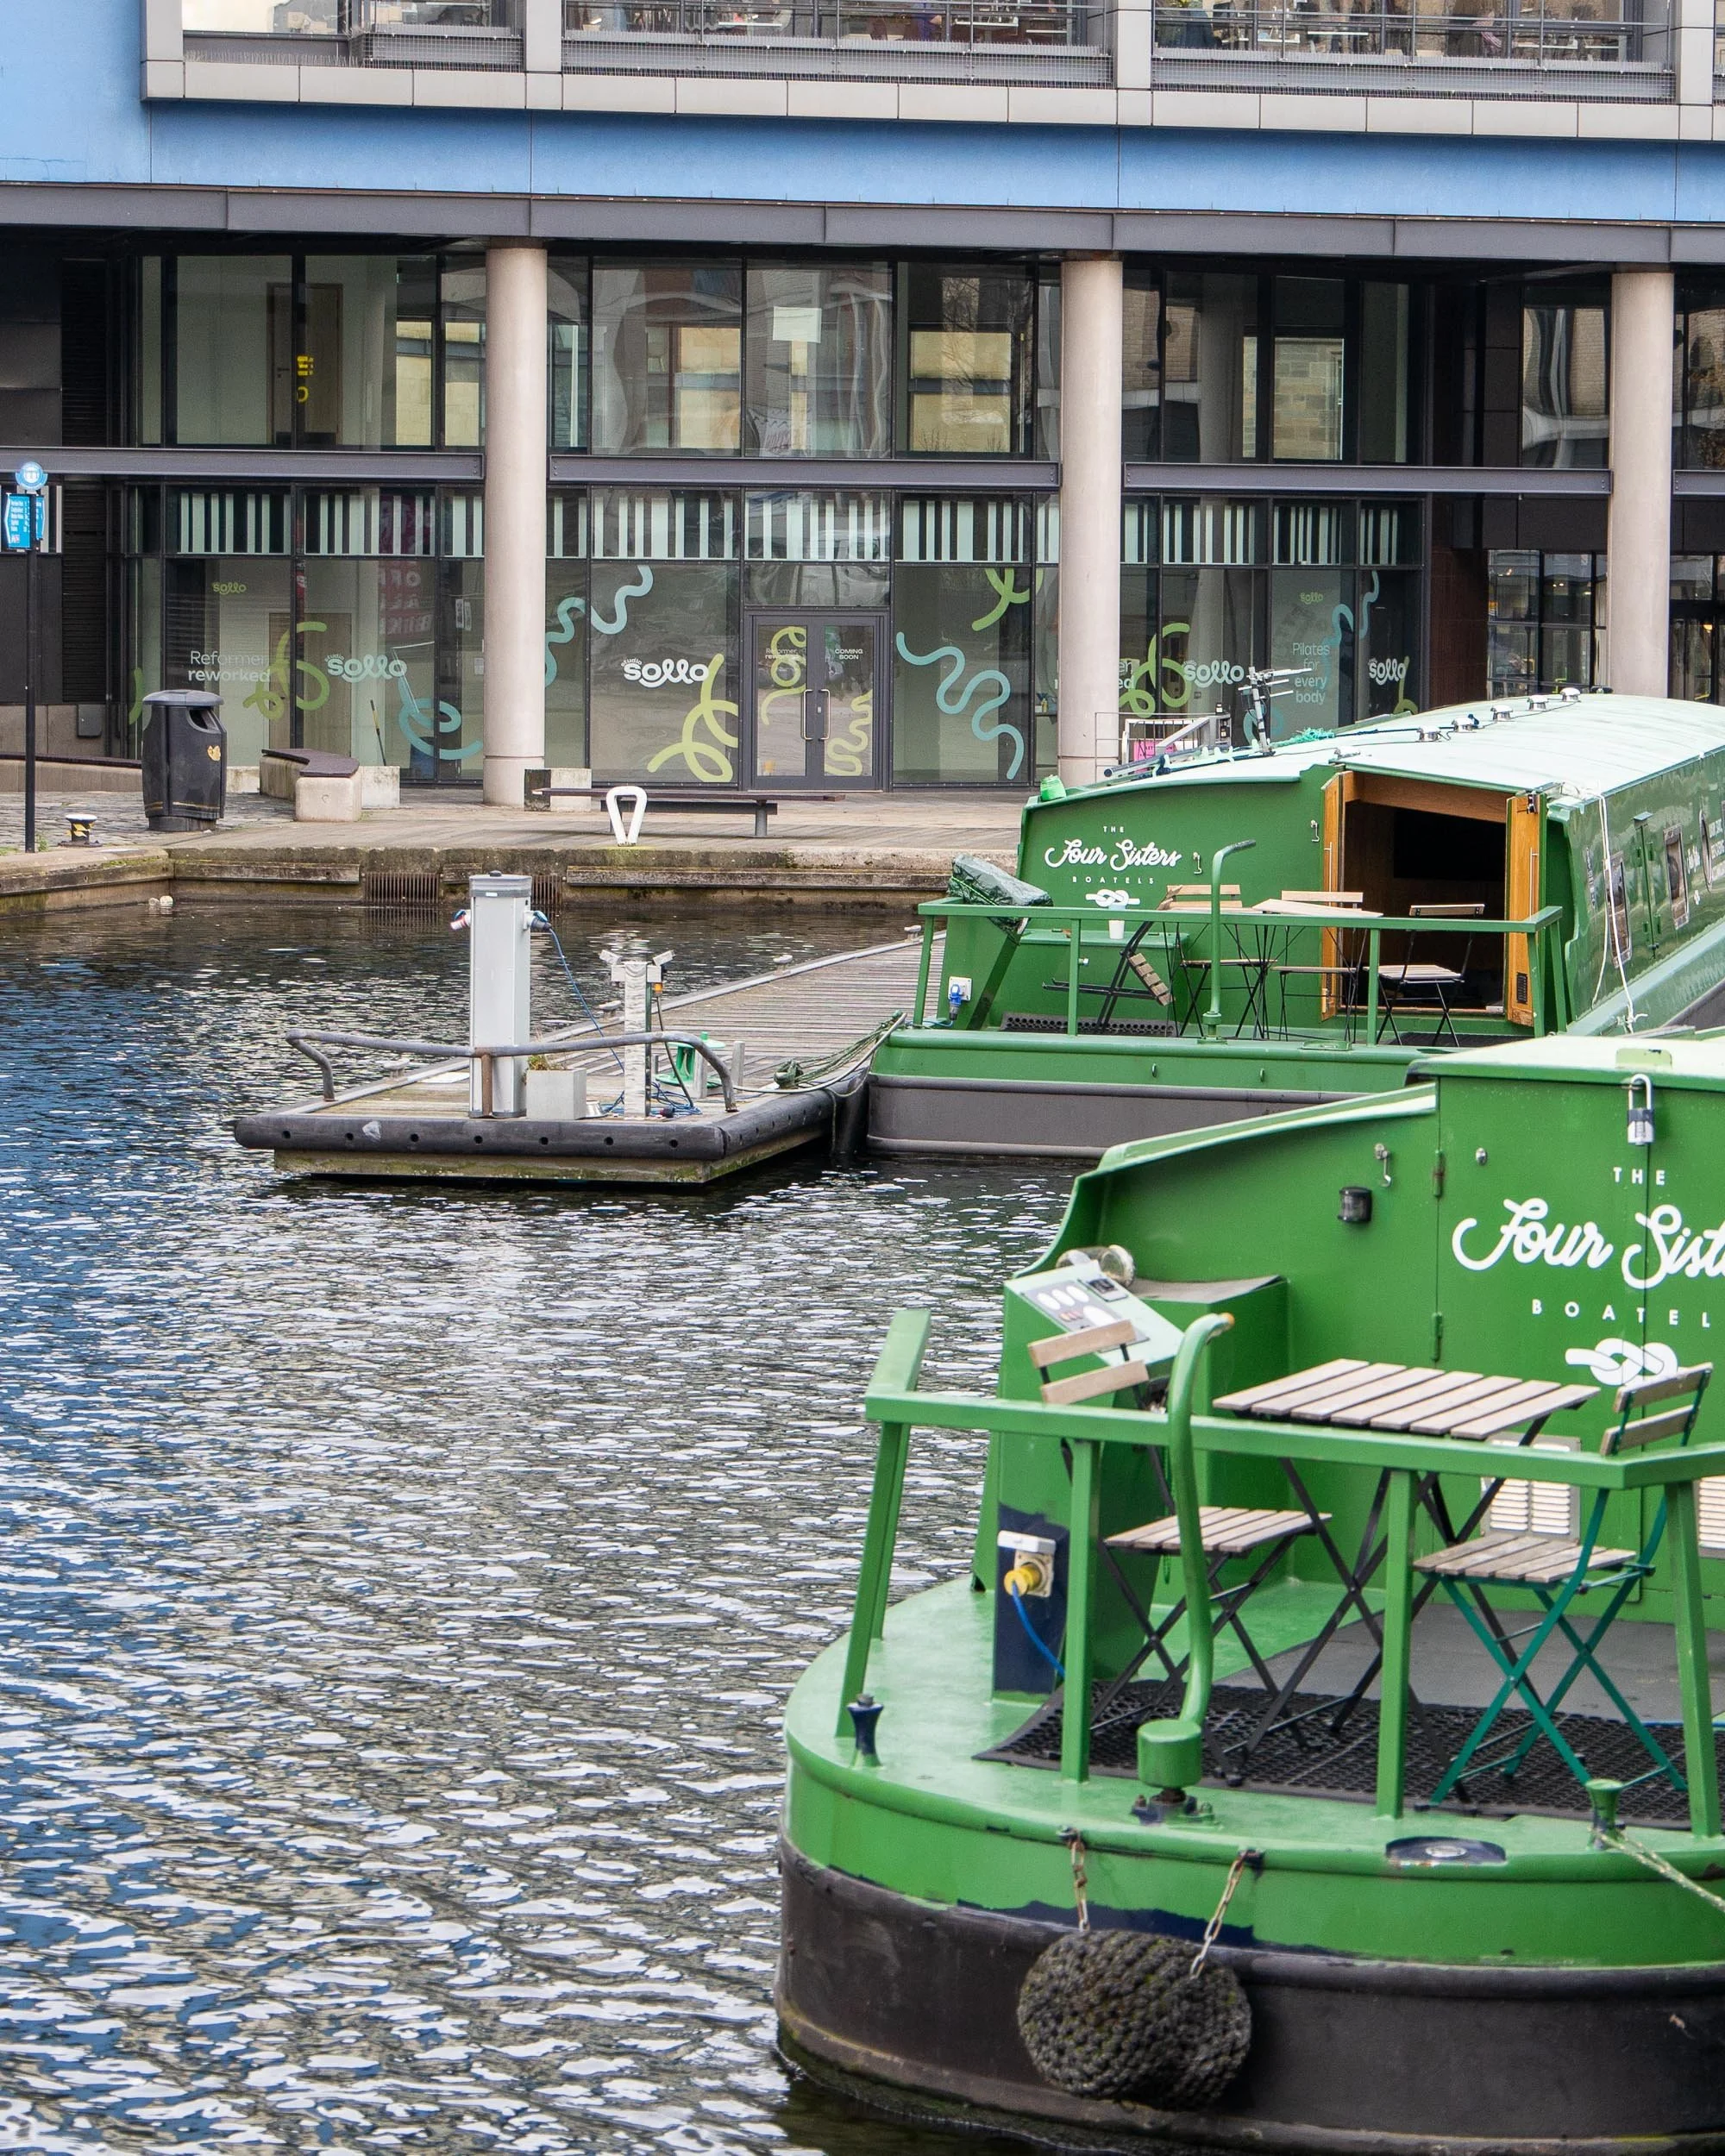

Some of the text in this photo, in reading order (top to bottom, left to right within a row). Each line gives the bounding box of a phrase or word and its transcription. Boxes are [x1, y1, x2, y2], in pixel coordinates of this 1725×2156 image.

[212, 581, 248, 594] sollo
[1300, 592, 1323, 604] sollo
[1293, 642, 1330, 655] Pilates
[191, 650, 264, 665] Reformer
[621, 657, 642, 667] studio
[1303, 658, 1320, 670] for
[188, 668, 271, 682] reworked
[327, 655, 407, 682] sollo
[624, 658, 709, 688] sollo
[1184, 660, 1245, 688] sollo
[1369, 658, 1406, 686] sollo
[1295, 676, 1327, 689] every
[1295, 691, 1326, 705] body
[1044, 839, 1182, 871] Four Sisters
[1613, 1166, 1665, 1185] THE
[1452, 1198, 1614, 1270] Four
[1532, 1299, 1710, 1328] BOATEL
